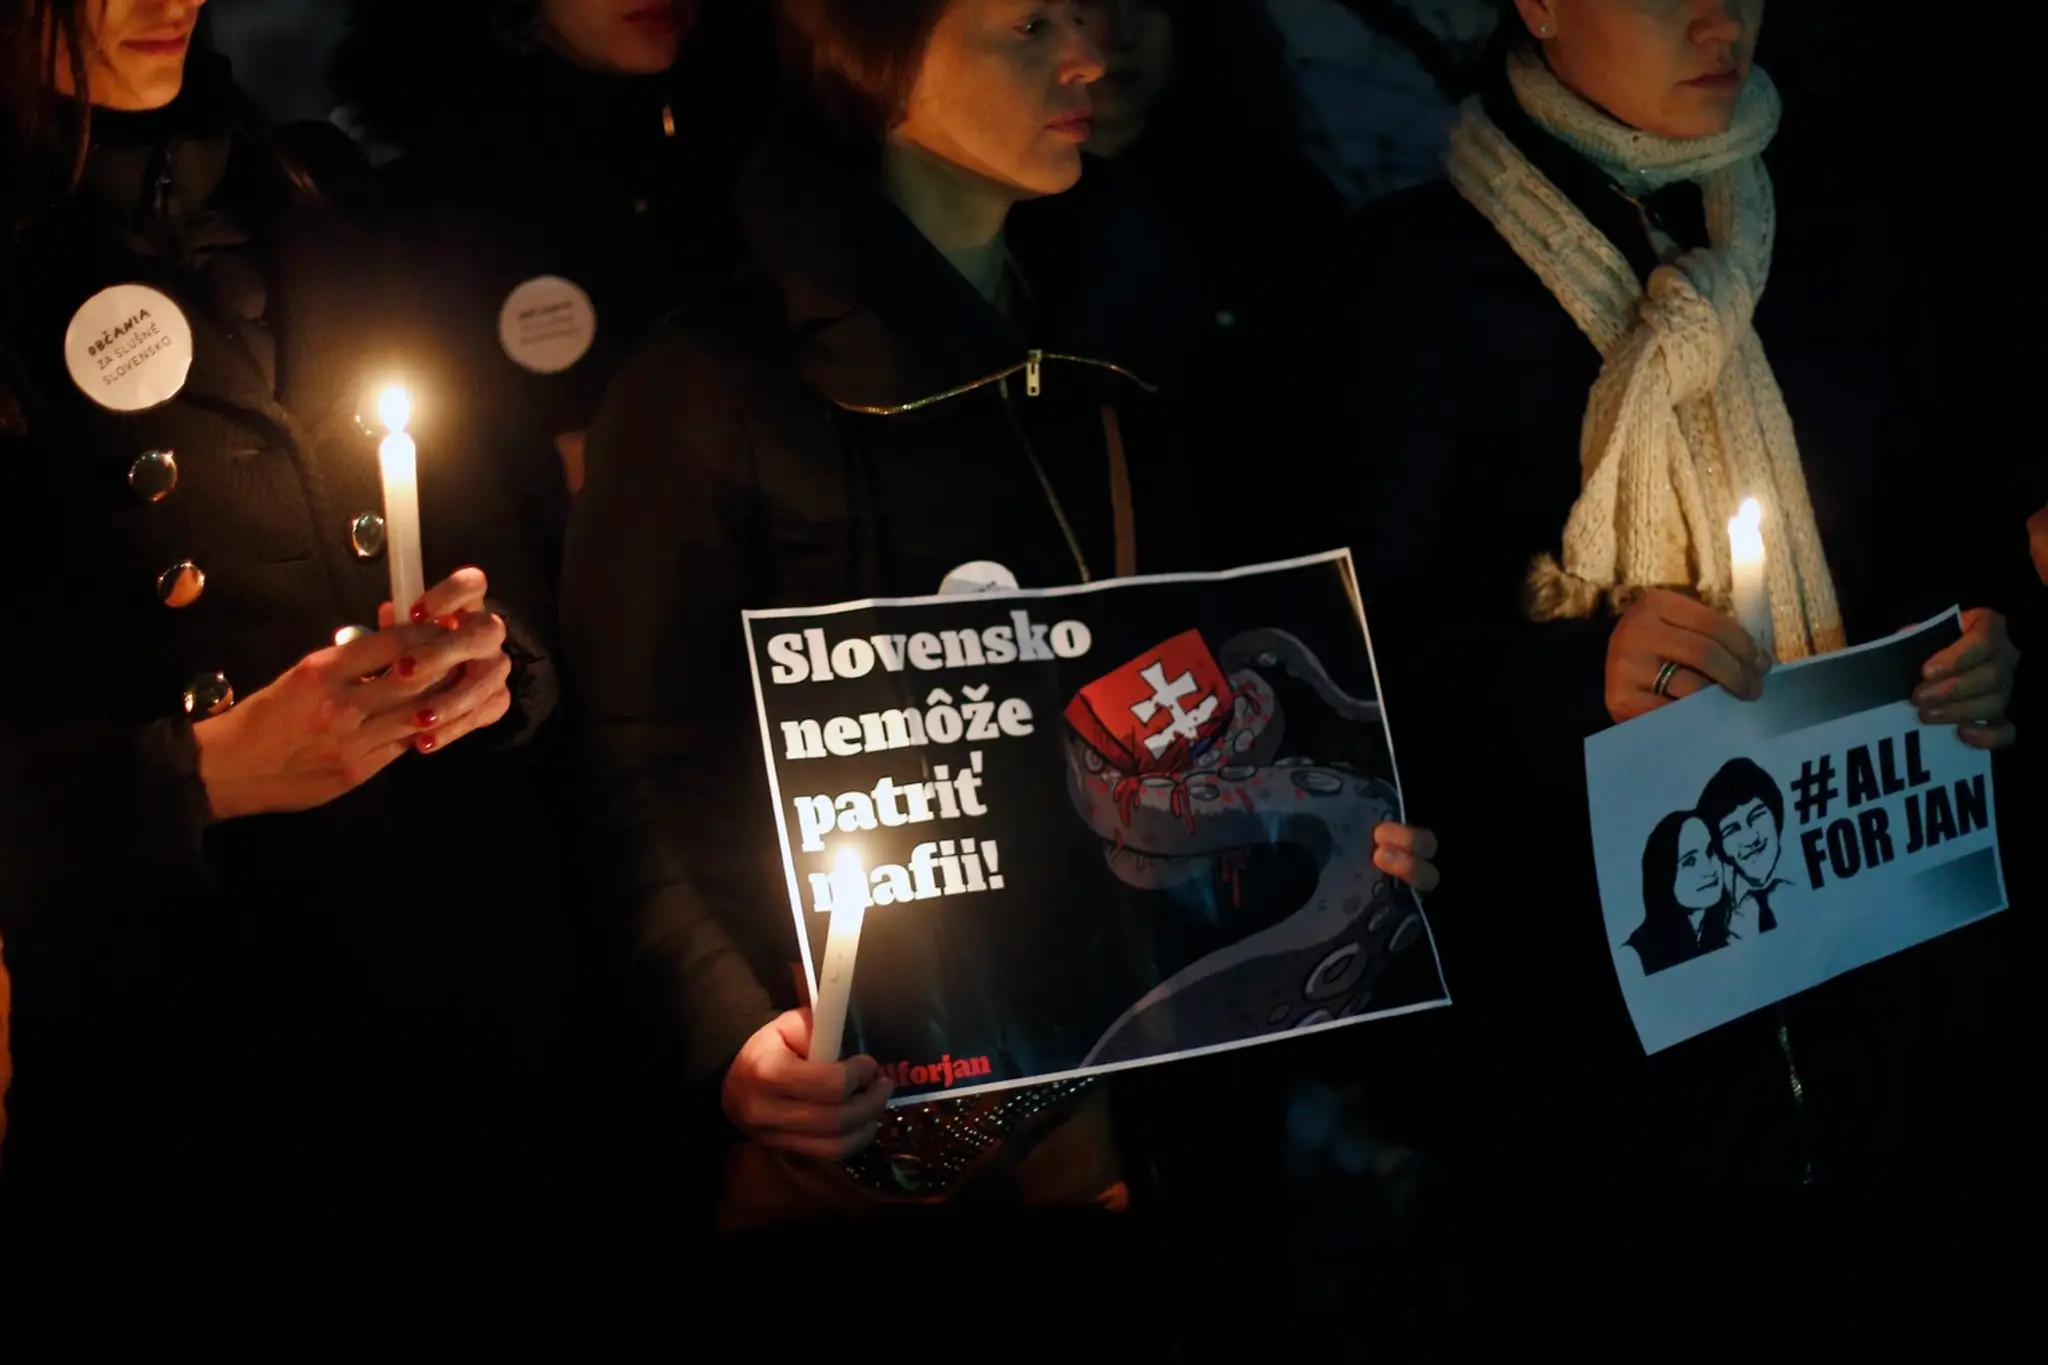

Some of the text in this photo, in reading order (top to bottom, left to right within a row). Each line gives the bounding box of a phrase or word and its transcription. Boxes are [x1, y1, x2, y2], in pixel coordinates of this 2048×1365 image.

[88, 308, 151, 357] OBČANIA
[97, 355, 113, 371] ZA
[102, 335, 172, 386] SLOVENSKO
[767, 609, 1092, 684] Slovensko
[780, 683, 1035, 760] nemôže
[794, 750, 988, 852] patriť
[1790, 729, 1931, 825] #ALL
[1800, 773, 1989, 891] FOR JAN
